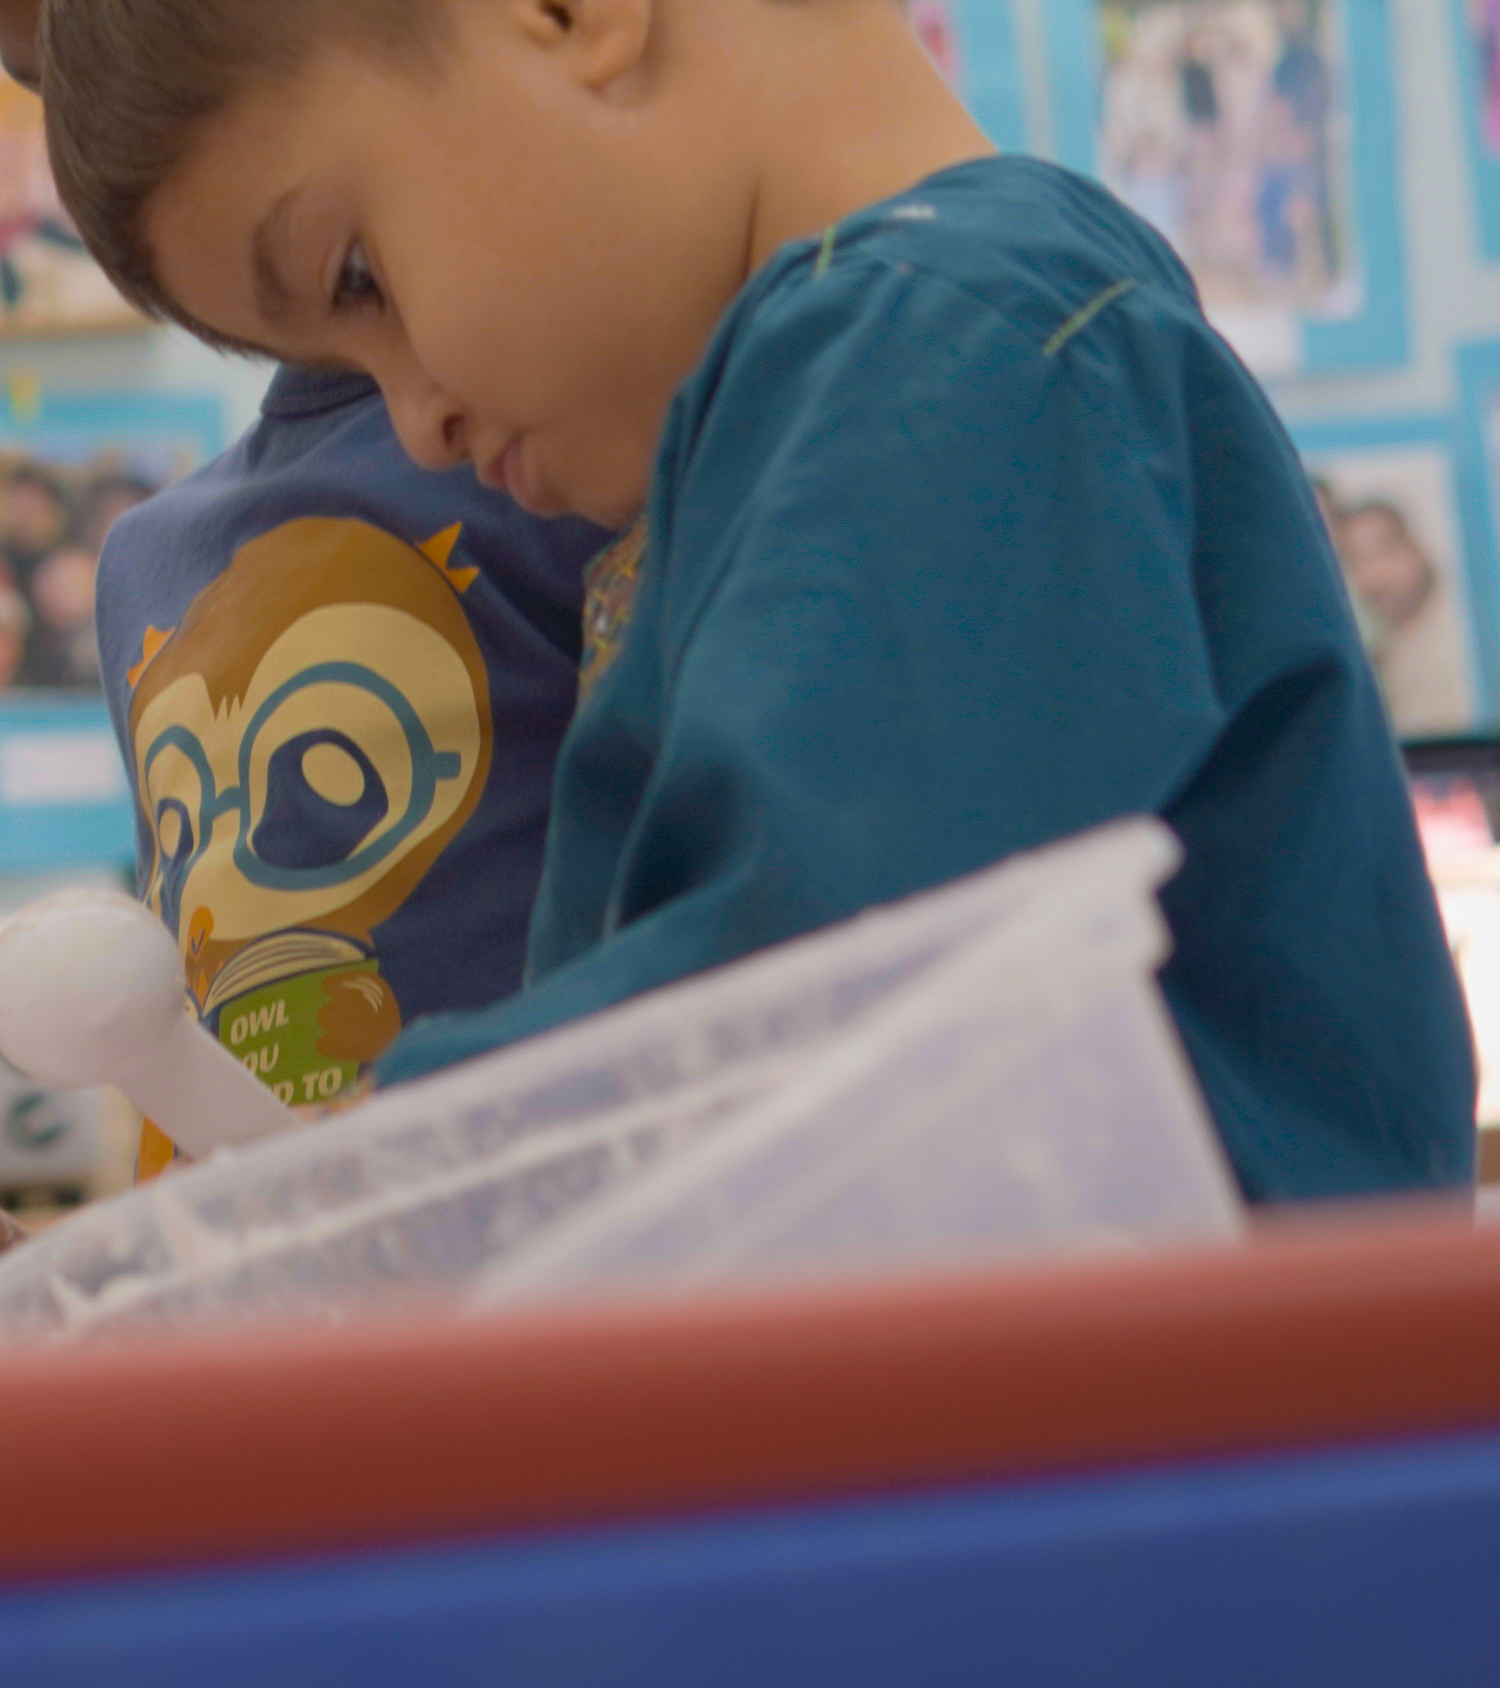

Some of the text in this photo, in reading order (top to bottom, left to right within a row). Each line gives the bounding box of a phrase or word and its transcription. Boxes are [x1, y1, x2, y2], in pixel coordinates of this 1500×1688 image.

[230, 999, 290, 1046] OWL
[240, 1041, 280, 1075] OU
[301, 1065, 343, 1101] TO
